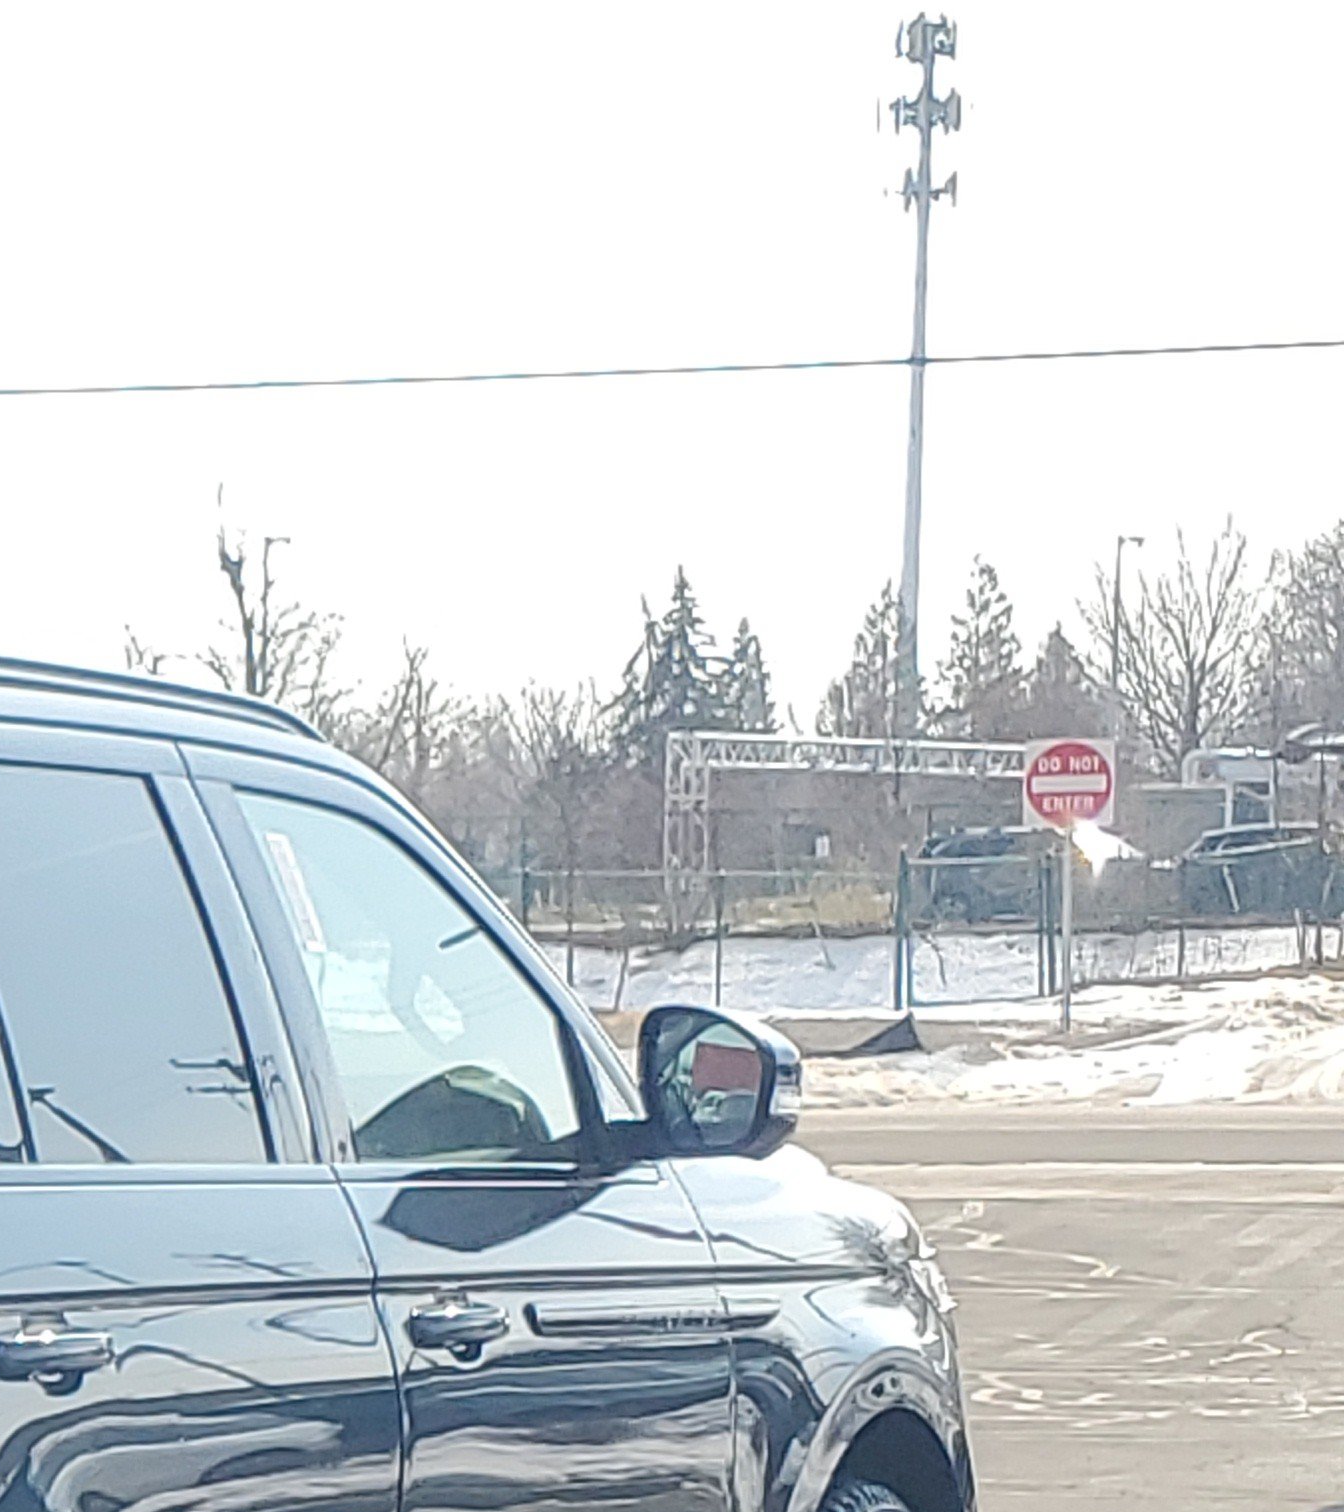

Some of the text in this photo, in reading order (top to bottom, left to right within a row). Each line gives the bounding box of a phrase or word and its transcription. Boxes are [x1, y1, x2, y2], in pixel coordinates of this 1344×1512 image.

[1038, 756, 1100, 774] DO NOT
[1043, 797, 1094, 813] ENTER
